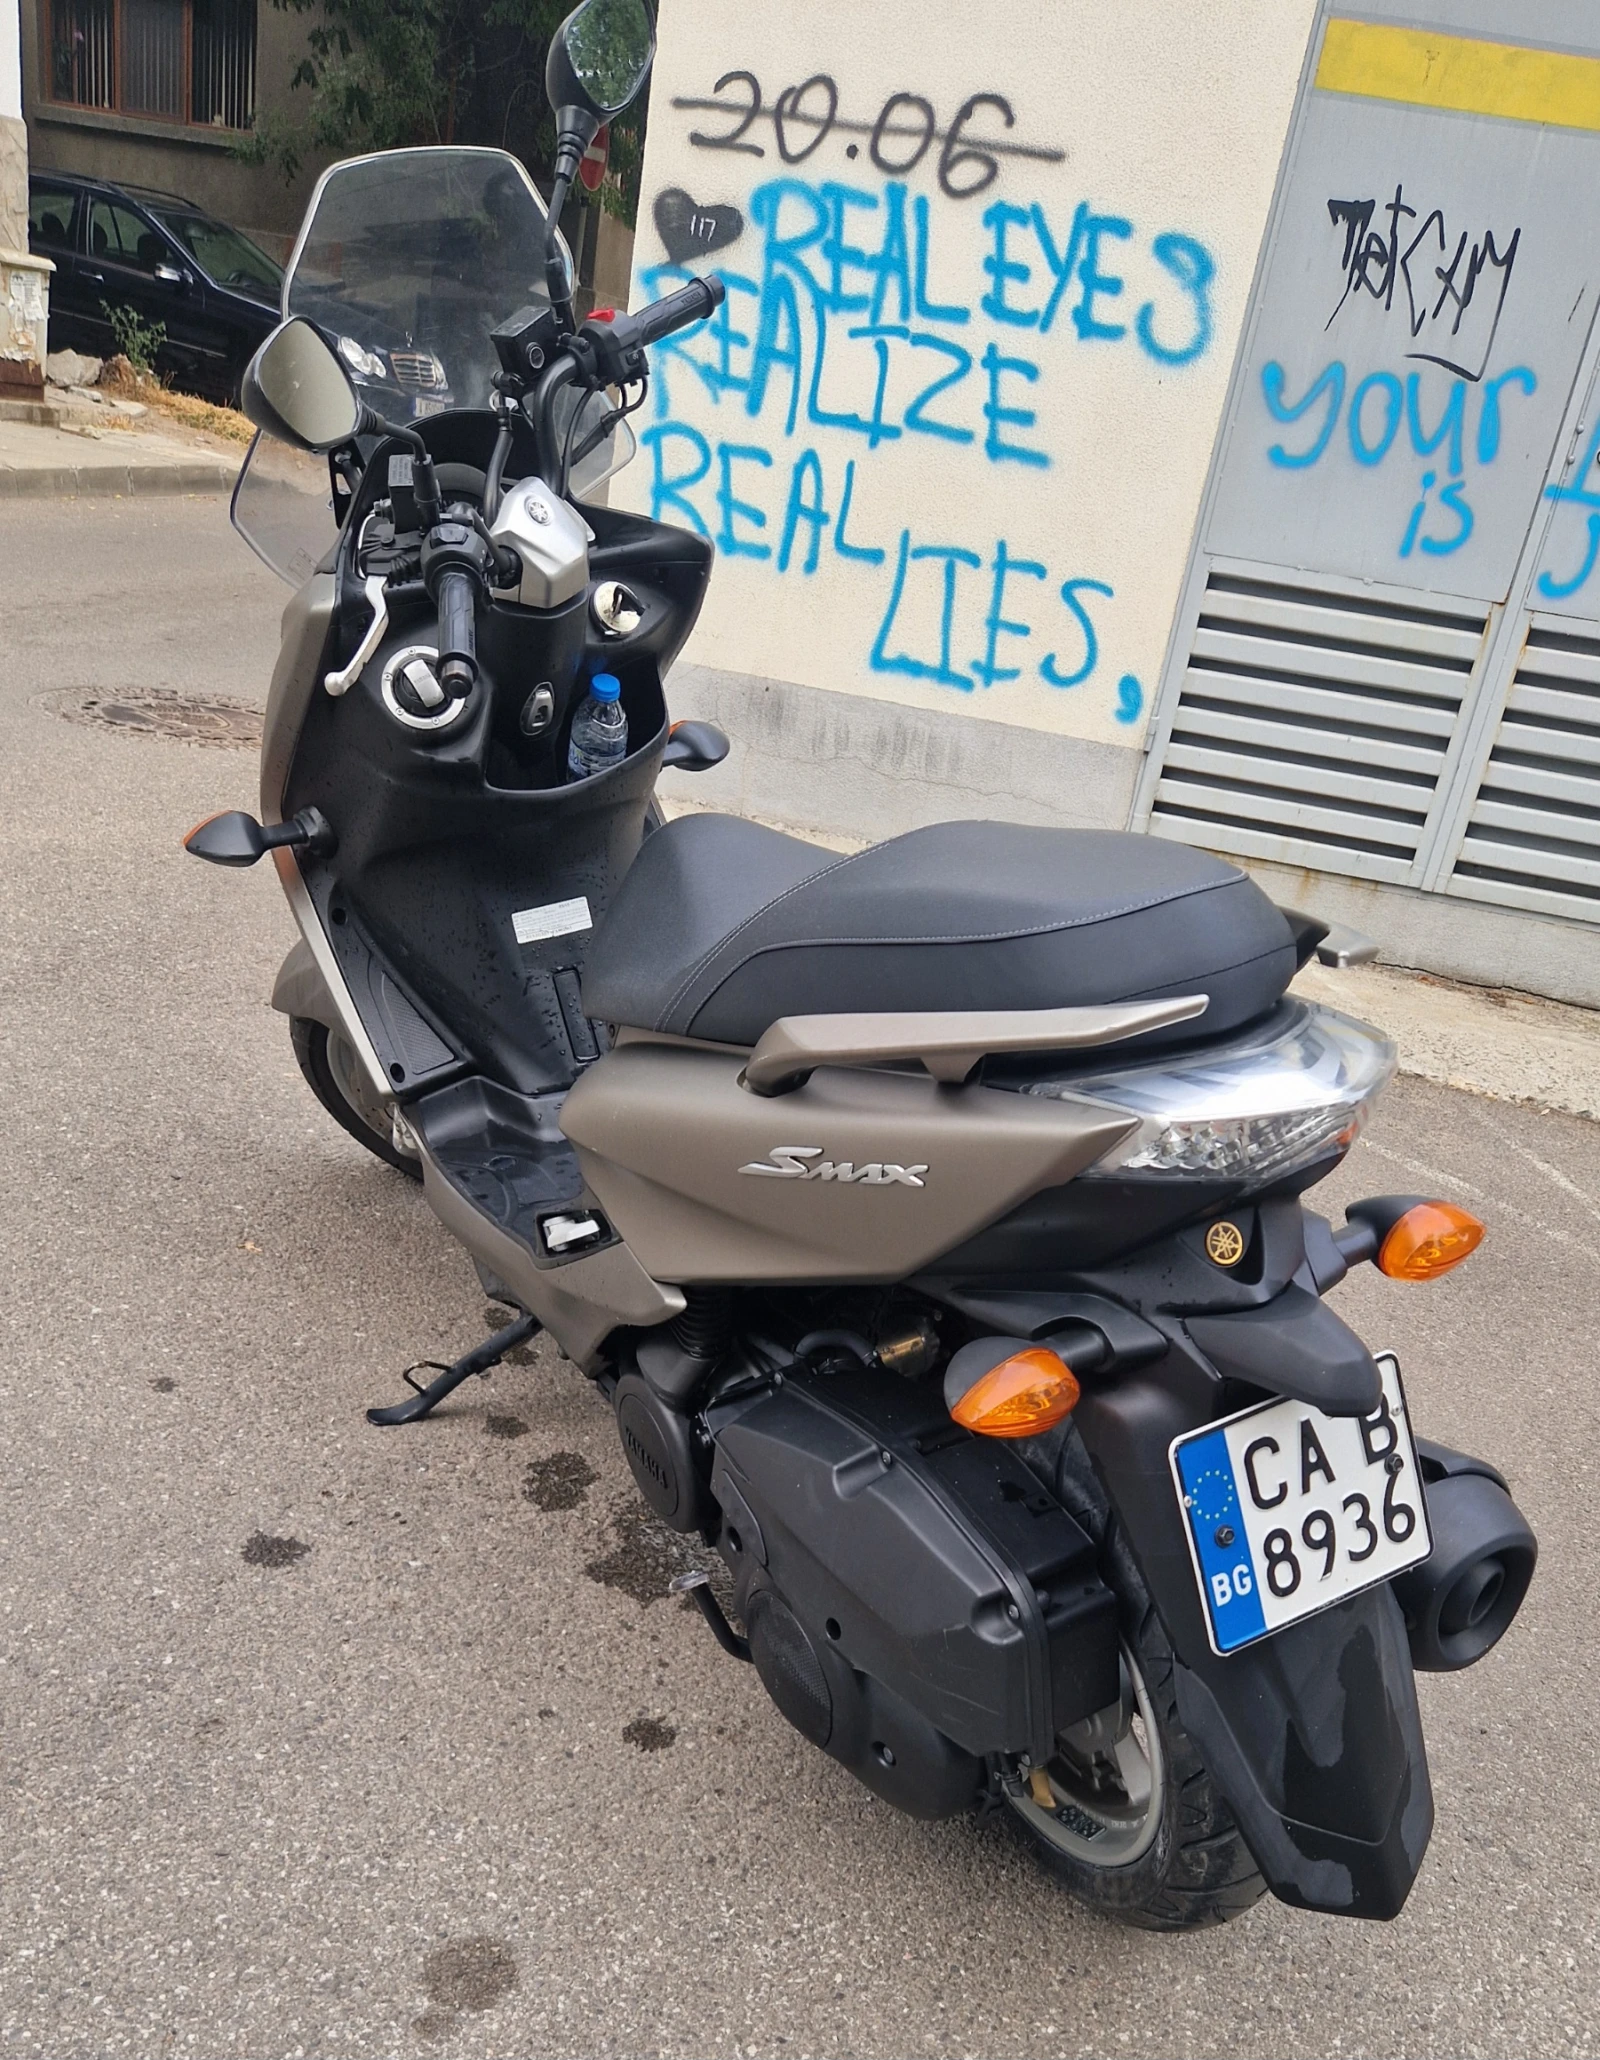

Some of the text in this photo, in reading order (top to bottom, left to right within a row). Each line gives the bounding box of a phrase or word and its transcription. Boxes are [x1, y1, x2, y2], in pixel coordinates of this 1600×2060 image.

[750, 178, 972, 325] REAL
[980, 198, 1215, 366] EYES
[638, 265, 1052, 472] REALIZE
[1261, 359, 1537, 476] your
[641, 420, 885, 576] REAL
[1398, 469, 1475, 560] is
[1242, 1417, 1338, 1511] CA
[1210, 1563, 1253, 1608] BG
[1262, 1475, 1417, 1599] 8936
